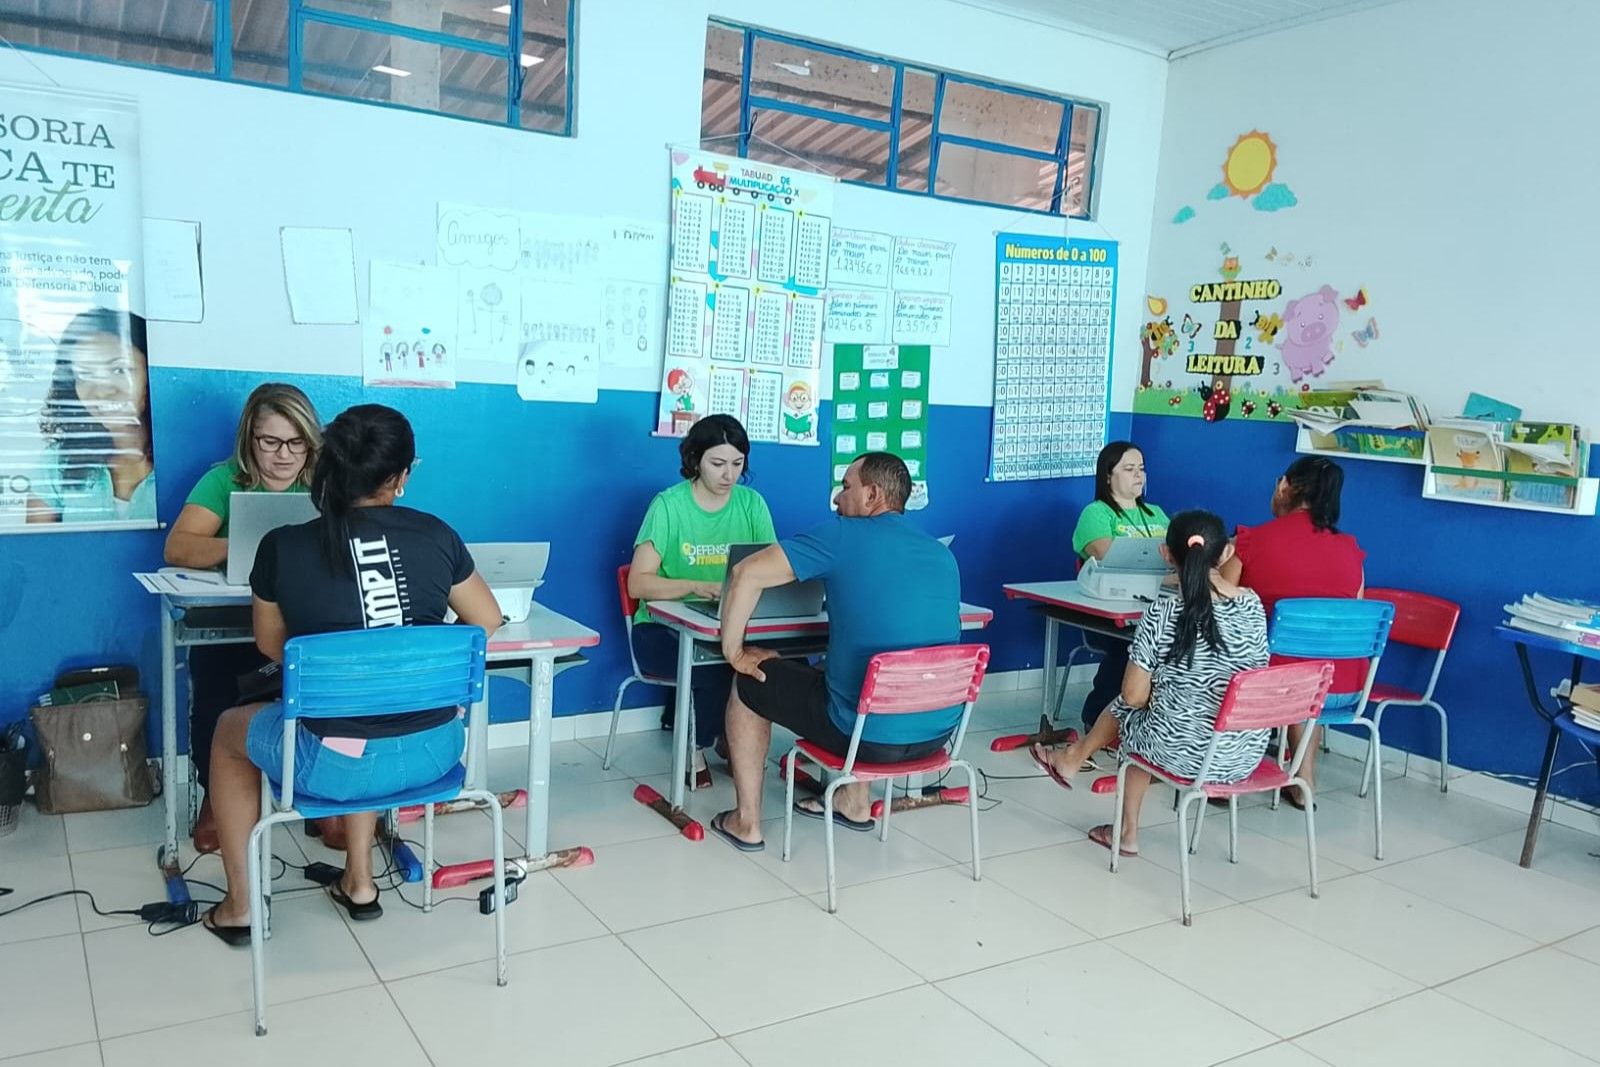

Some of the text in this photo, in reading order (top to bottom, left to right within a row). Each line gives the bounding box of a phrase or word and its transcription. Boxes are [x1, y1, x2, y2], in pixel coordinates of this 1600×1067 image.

[62, 160, 116, 189] TE
[1005, 242, 1107, 262] Números de 0 a 100
[89, 255, 112, 266] tem
[1004, 265, 1110, 278] 0 1 2 3 4 5 6 7 8 9
[1001, 286, 1110, 298] 10 11 12 13 14 15 16 17 18 19
[1190, 280, 1281, 302] CANTINHO
[1214, 321, 1237, 339] DA
[1245, 337, 1252, 349] 2
[1187, 355, 1260, 375] LEITURA
[1273, 363, 1280, 375] 3
